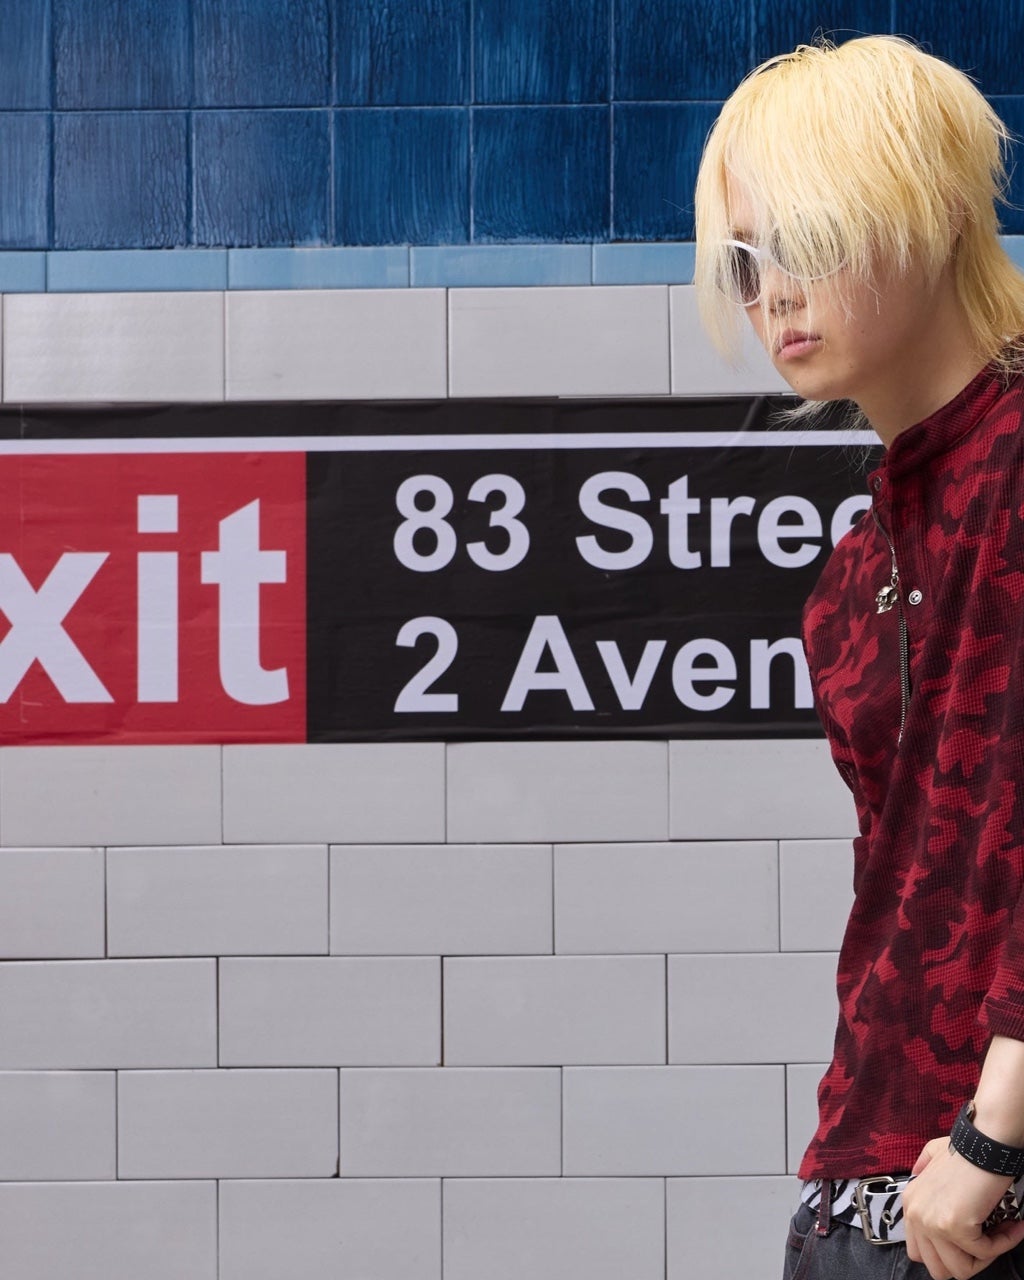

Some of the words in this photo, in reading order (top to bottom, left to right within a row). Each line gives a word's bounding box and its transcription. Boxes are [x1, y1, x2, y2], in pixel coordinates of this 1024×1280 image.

[393, 473, 530, 571] 83
[0, 494, 290, 705] xit
[394, 616, 458, 712] 2
[501, 615, 814, 712] Aven
